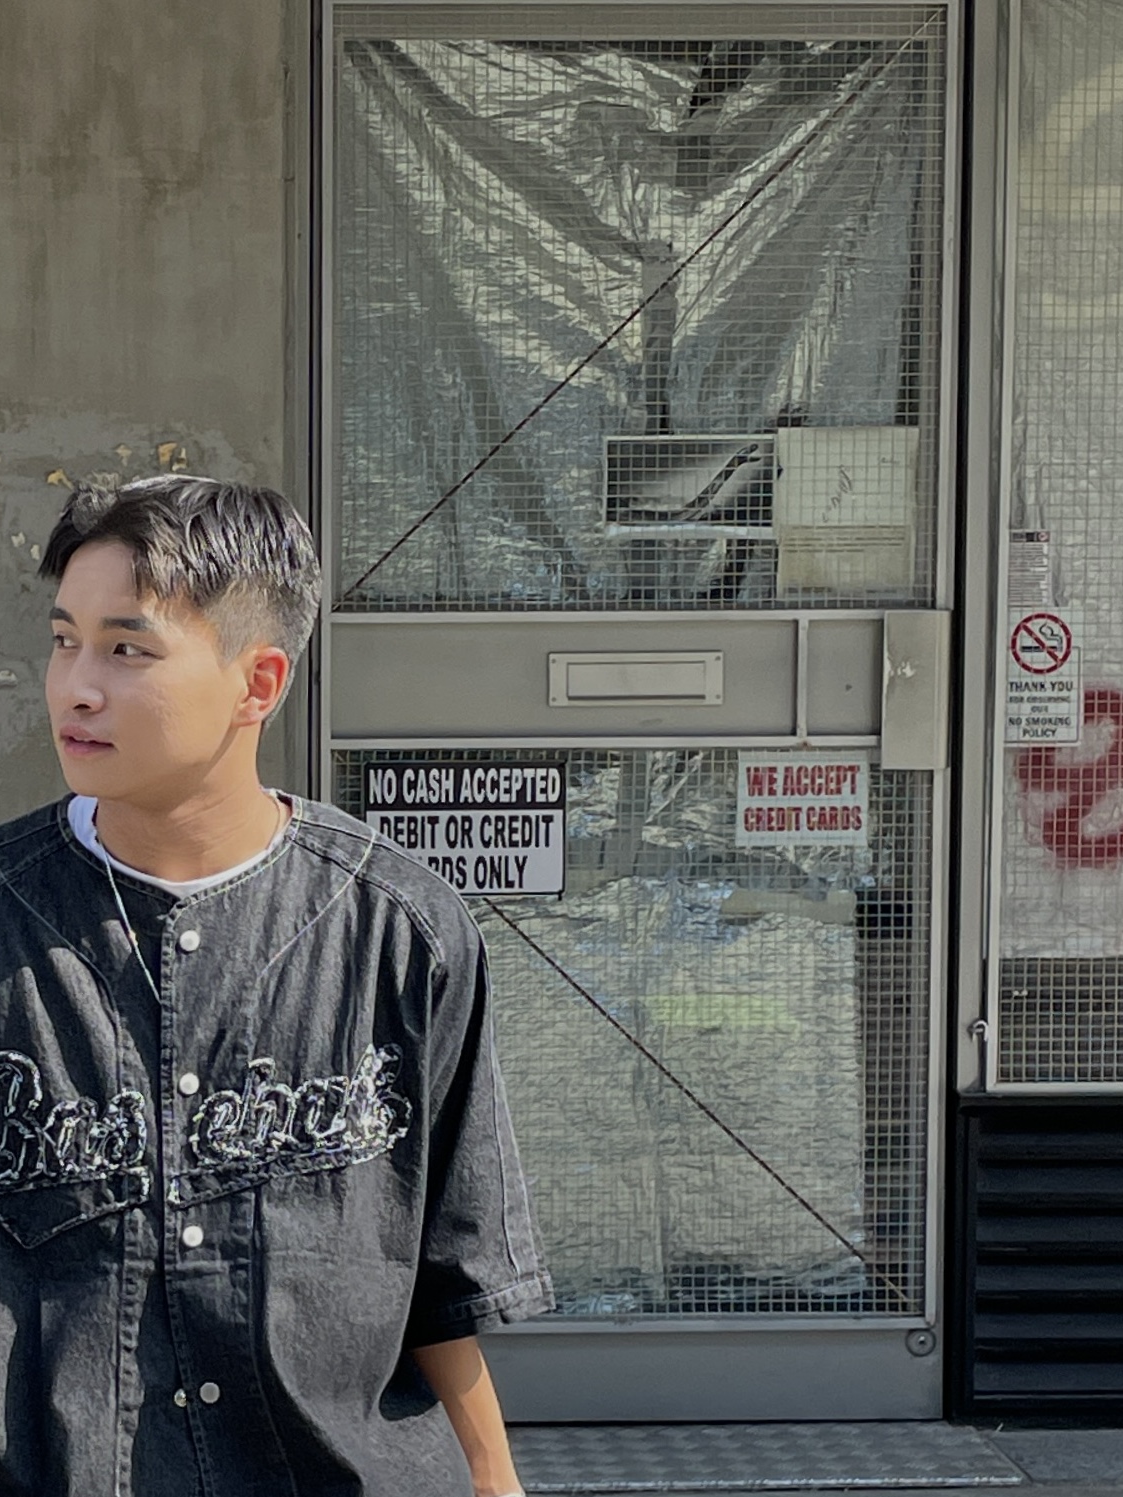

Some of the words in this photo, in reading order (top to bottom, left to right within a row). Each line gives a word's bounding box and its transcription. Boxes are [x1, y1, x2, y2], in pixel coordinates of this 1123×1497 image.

[1009, 681, 1047, 692] THANK
[1050, 681, 1073, 692] YOU
[1008, 717, 1023, 726] NO
[1025, 716, 1071, 727] SMOKING
[1022, 728, 1057, 737] POLICY
[369, 768, 397, 804] NO
[402, 768, 455, 803] CASH
[459, 767, 561, 803] ACCEPTED
[746, 766, 778, 797] WE
[782, 765, 860, 797] ACCEPT
[380, 815, 439, 849] DEBIT
[444, 815, 473, 849] OR
[479, 815, 554, 848] CREDIT
[744, 807, 802, 832] CREDIT
[806, 805, 862, 831] CARDS
[473, 855, 528, 889] ONLY
